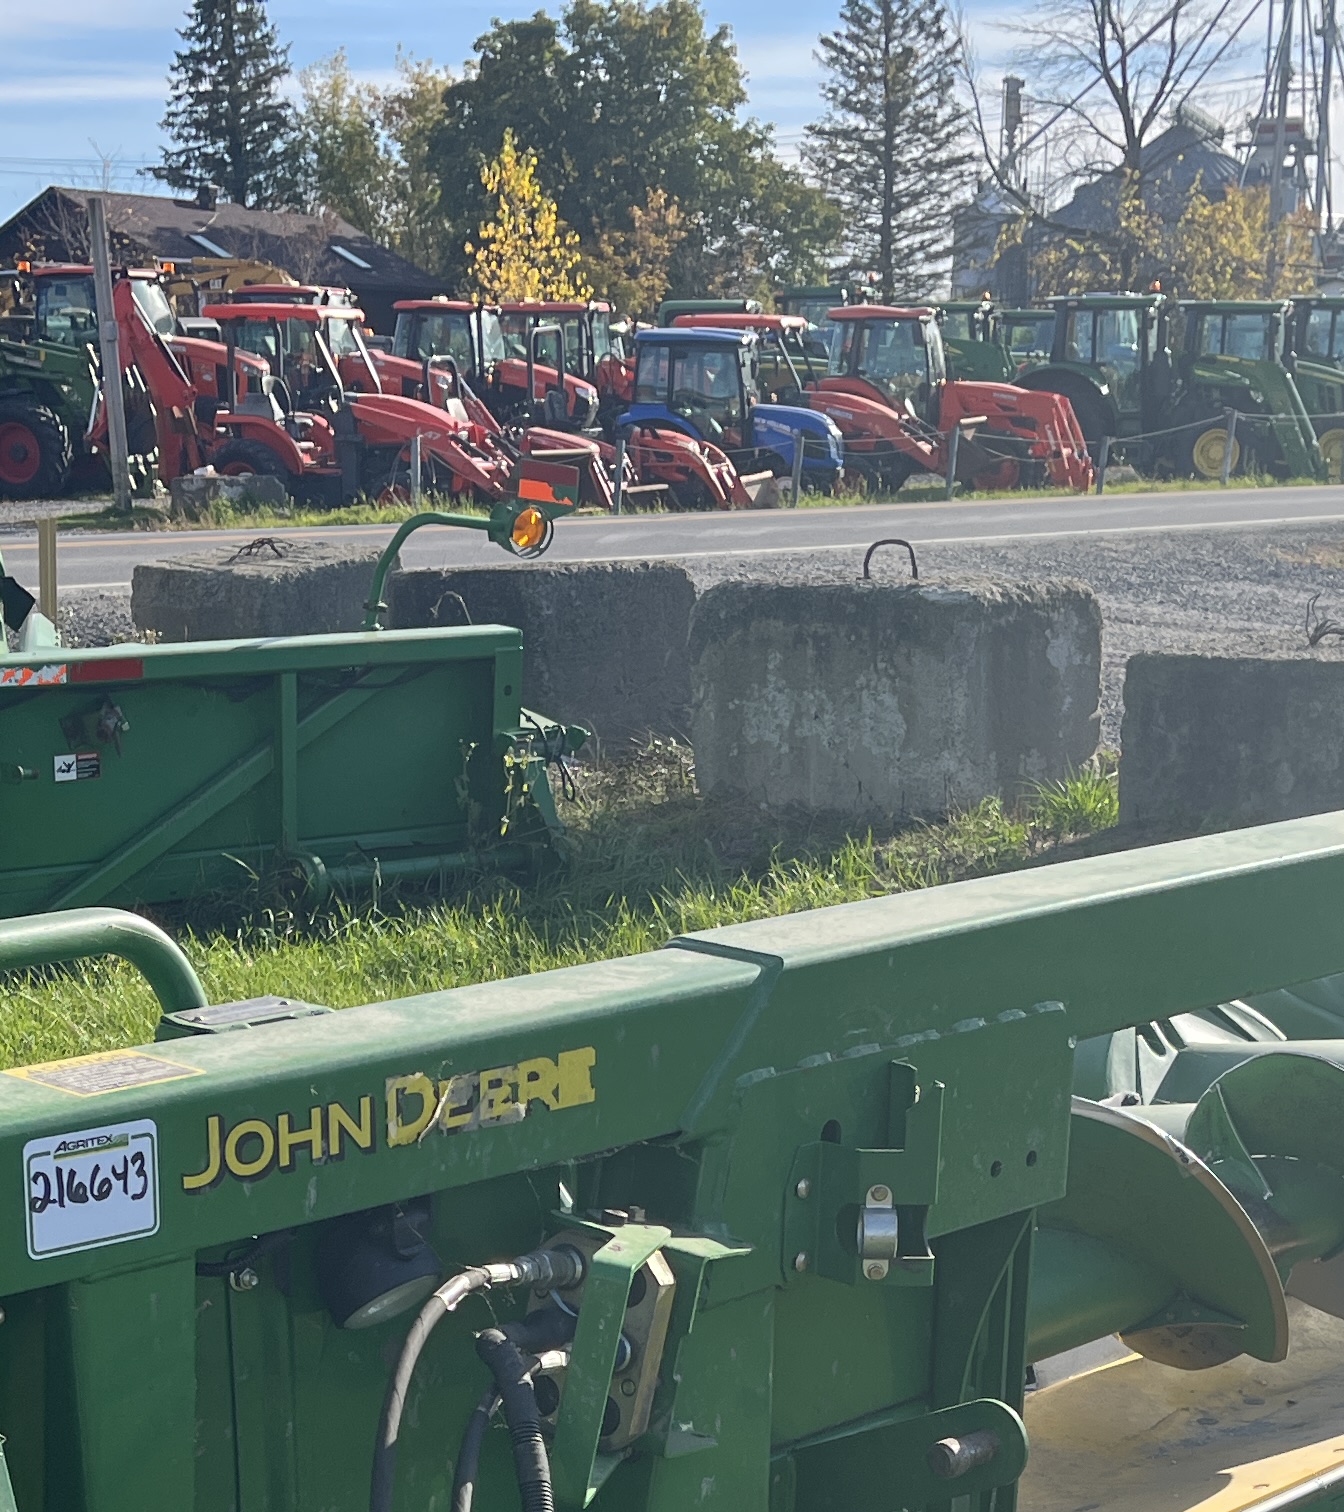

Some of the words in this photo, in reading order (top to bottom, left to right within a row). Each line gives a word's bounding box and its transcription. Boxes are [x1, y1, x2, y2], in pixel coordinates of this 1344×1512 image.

[54, 1134, 113, 1154] AGRITEX
[183, 1096, 374, 1192] JOHN
[30, 1151, 148, 1213] 216643
